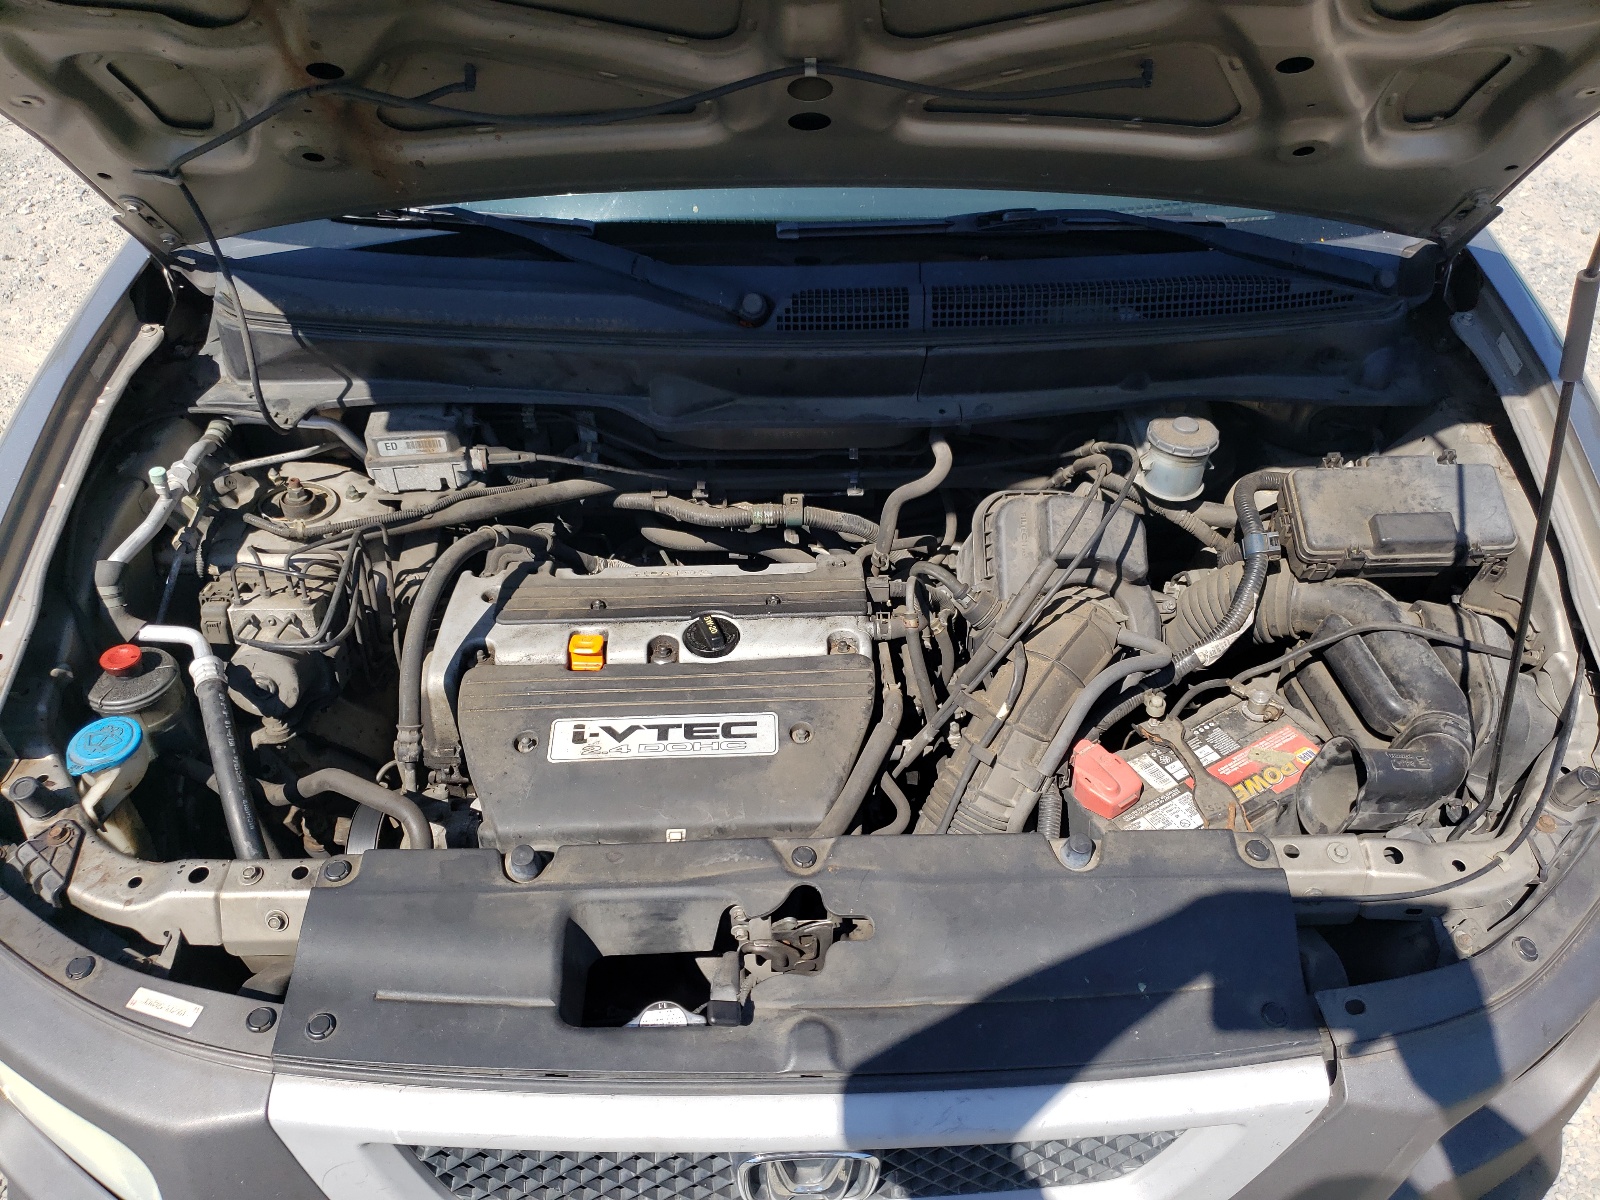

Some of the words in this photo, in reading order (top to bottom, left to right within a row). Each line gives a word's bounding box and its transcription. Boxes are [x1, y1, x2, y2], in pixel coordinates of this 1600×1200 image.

[384, 442, 398, 451] ED
[571, 721, 758, 745] i-VTEC
[580, 743, 631, 756] 2.4
[638, 740, 747, 754] DOHC
